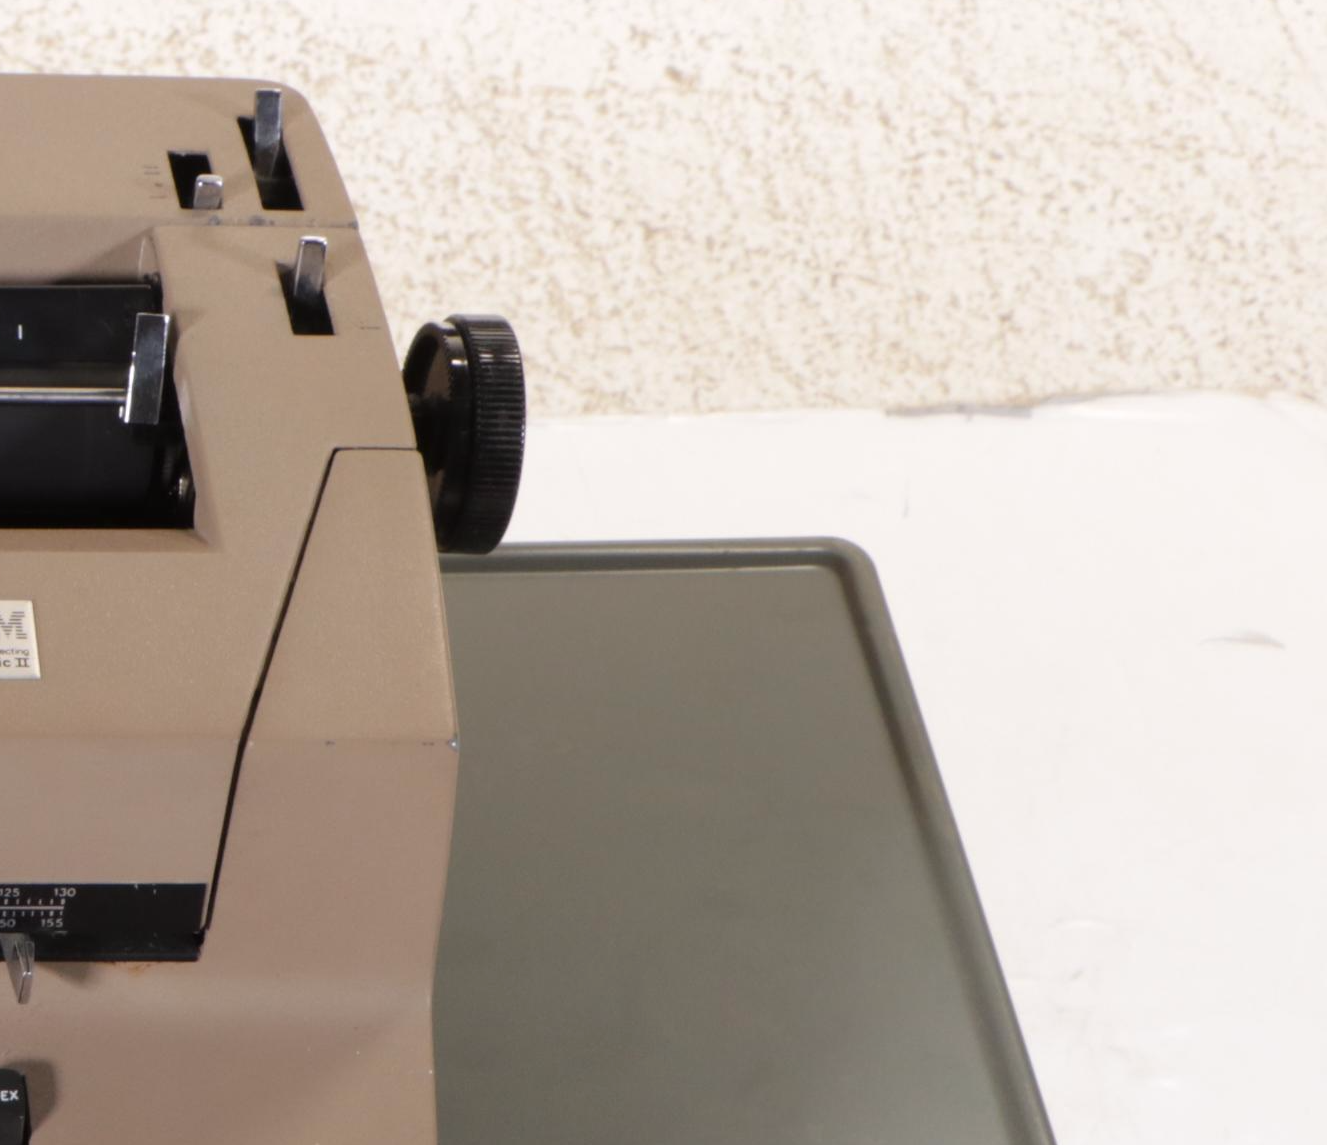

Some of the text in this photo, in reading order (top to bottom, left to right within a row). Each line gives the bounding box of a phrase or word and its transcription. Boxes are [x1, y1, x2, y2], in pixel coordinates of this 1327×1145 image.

[0, 888, 19, 897] 125
[55, 888, 76, 897] 130
[42, 918, 63, 927] 155
